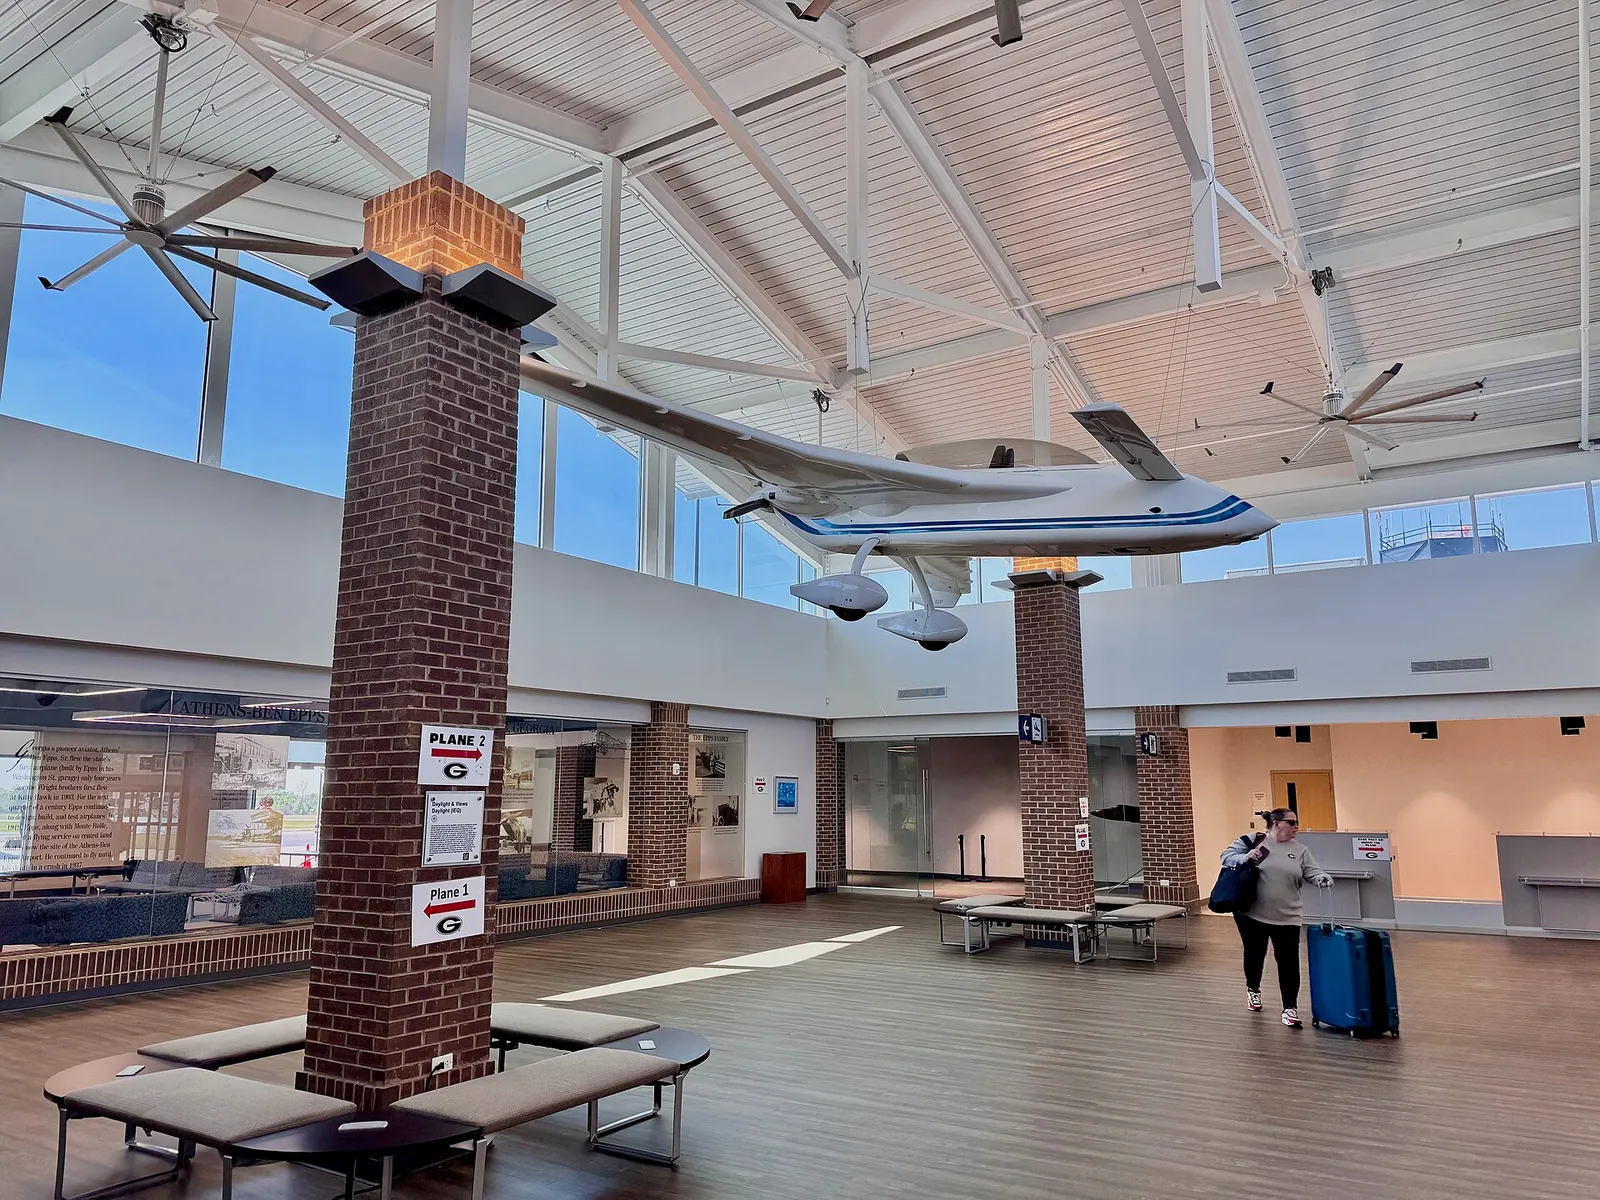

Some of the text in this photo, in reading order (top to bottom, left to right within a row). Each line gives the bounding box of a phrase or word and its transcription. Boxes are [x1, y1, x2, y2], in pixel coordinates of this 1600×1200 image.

[180, 701, 326, 723] ATHENS-BEN EPPS
[512, 722, 555, 735] GEORGIA
[429, 732, 486, 747] PLANE 2
[430, 883, 469, 900] Plane 1
